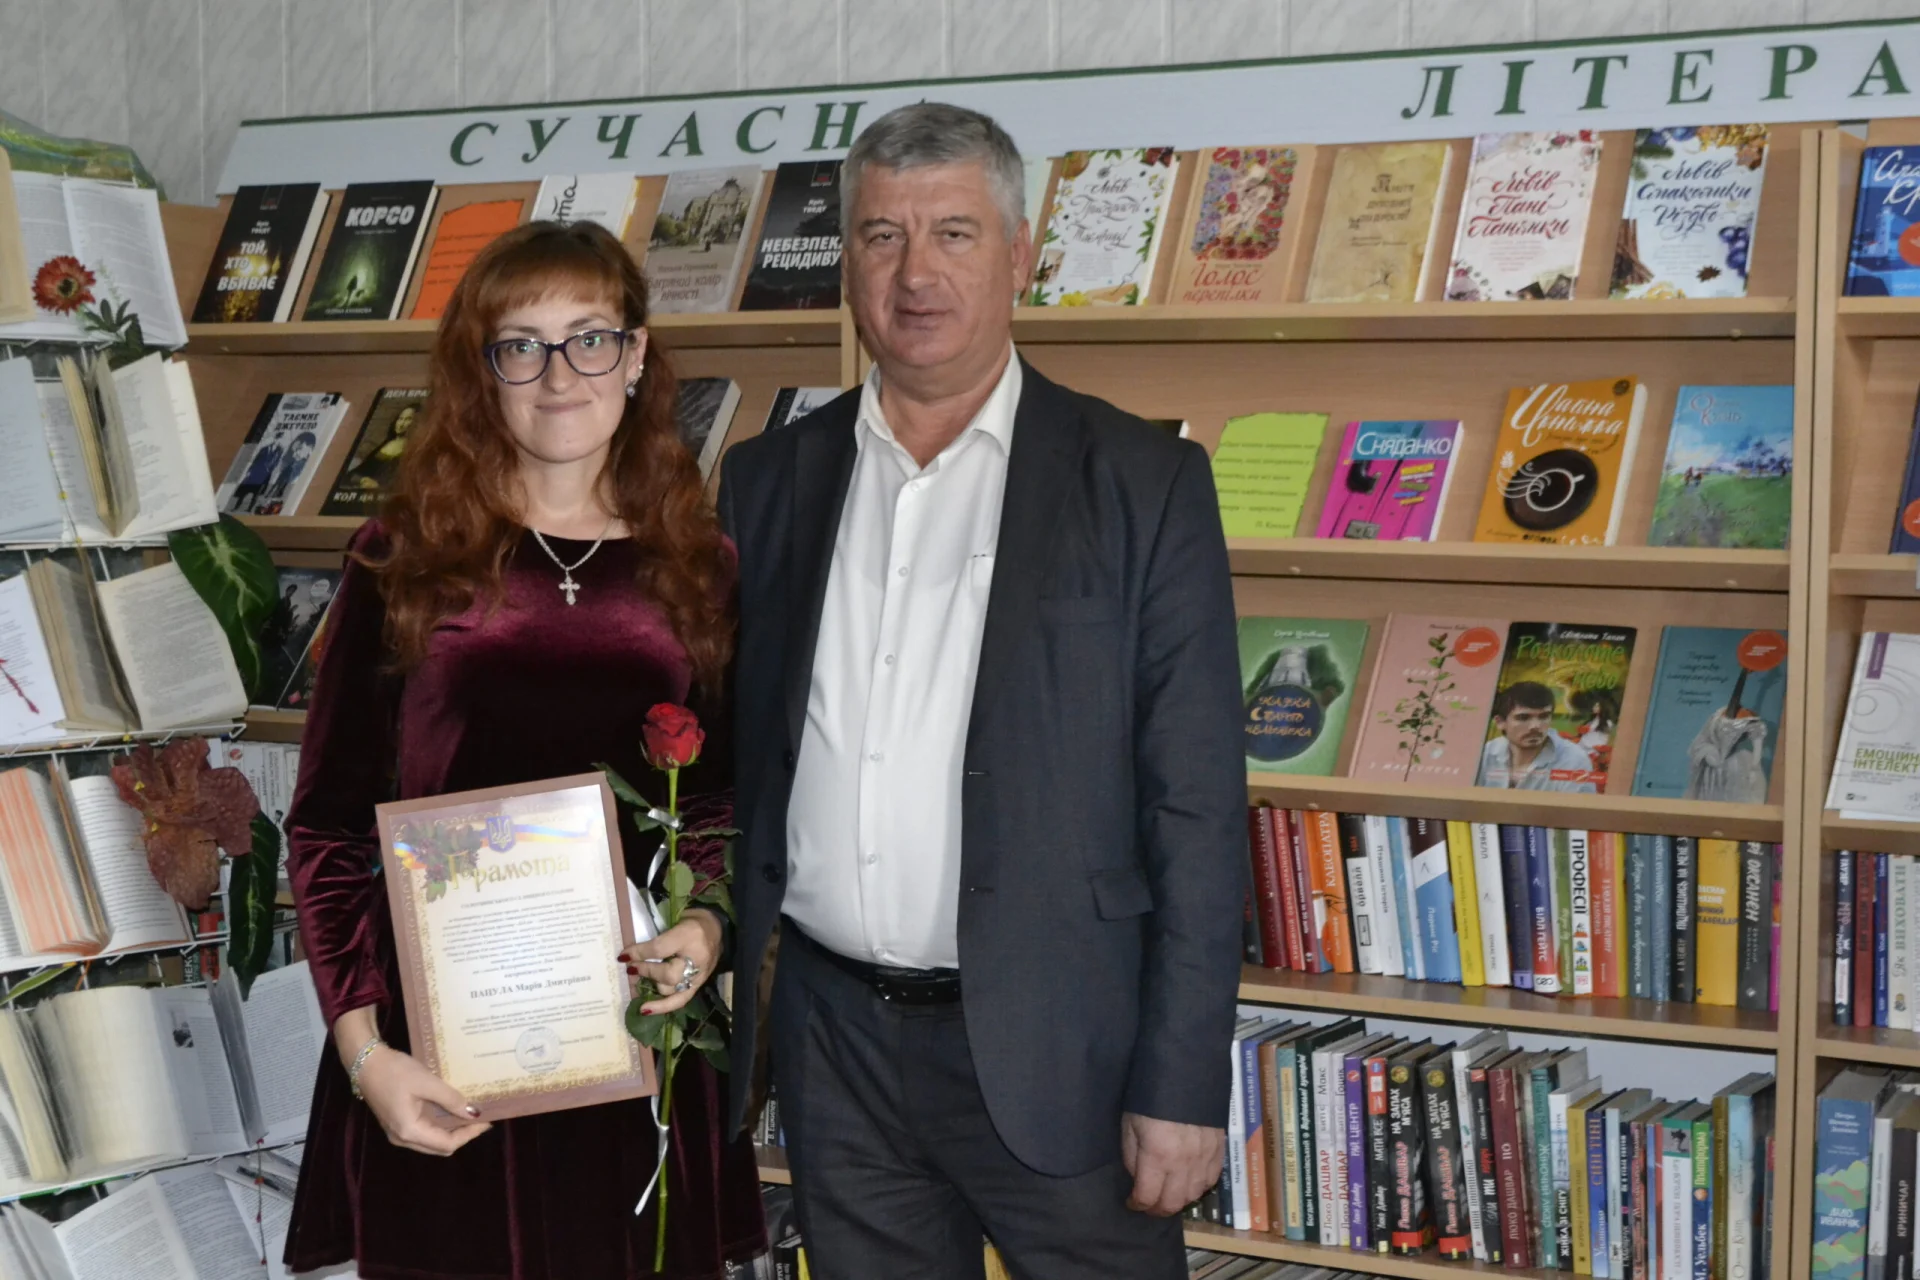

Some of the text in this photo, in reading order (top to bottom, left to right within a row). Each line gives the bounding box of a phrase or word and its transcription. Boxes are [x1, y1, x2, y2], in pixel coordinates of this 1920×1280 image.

[449, 101, 867, 166] СУЧАСН
[345, 205, 415, 228] КОРСО
[240, 239, 269, 256] ТОЙ,
[761, 236, 842, 253] НЕБЕЗПЕК
[224, 256, 251, 271] ХТО
[762, 251, 842, 270] РЕЦИДИВУ
[217, 275, 278, 292] ВБИВАЄ
[1191, 266, 1264, 286] Голос
[384, 389, 406, 399] ДЕН
[274, 422, 318, 432] ДЖЕРЕЛО
[283, 413, 320, 423] ТАЄМНЕ
[1355, 431, 1451, 459] Сняданко
[333, 491, 357, 502] КОД
[1516, 634, 1627, 664] Розколоте
[1853, 758, 1918, 774] ІНТЕЛЕКТ
[1318, 811, 1336, 888] КЛЕОПАТРА
[1478, 823, 1490, 859] ОРВЕЛЛ
[448, 853, 571, 893] Грамота
[1571, 838, 1589, 916] ПРОФЕСІЇ
[1675, 845, 1690, 931] ПІДПИШИСЬ НА МЕНЕ
[1746, 859, 1762, 922] ОКСАНЕН
[1535, 906, 1545, 930] БІЛЛ
[1894, 864, 1907, 950] ВИХОВАТИ
[515, 975, 592, 992] Марія Дмитрівна
[1317, 1066, 1327, 1096] Макс
[1390, 1088, 1401, 1134] НА ЗАПАХ
[1400, 1096, 1411, 1126] М'ЯСА
[1427, 1092, 1442, 1139] НА ЗАПАХ
[1439, 1099, 1451, 1130] М'ЯСА
[1374, 1119, 1384, 1136] ВСЕ
[1375, 1137, 1385, 1161] МАТИ
[1693, 1131, 1708, 1186] Платформа
[1301, 1140, 1313, 1198] Нижанківський
[1320, 1149, 1332, 1201] ДАШВАР
[1337, 1150, 1350, 1202] ДАШВАР
[1395, 1141, 1411, 1229] Люко ДАШВАР
[1438, 1145, 1458, 1234] Люко ДАШВАР
[1504, 1169, 1517, 1209] ДАШВАР
[1537, 1143, 1553, 1228] Жіночий лікар
[1304, 1198, 1315, 1227] Богдан
[1321, 1202, 1332, 1230] Люко
[1557, 1189, 1570, 1257] ЖІНКА ЗІ СНІГУ
[1896, 1180, 1909, 1237] КРИНИЧАР
[1508, 1212, 1519, 1240] ЛЮКО
[1693, 1223, 1707, 1266] Уельбек
